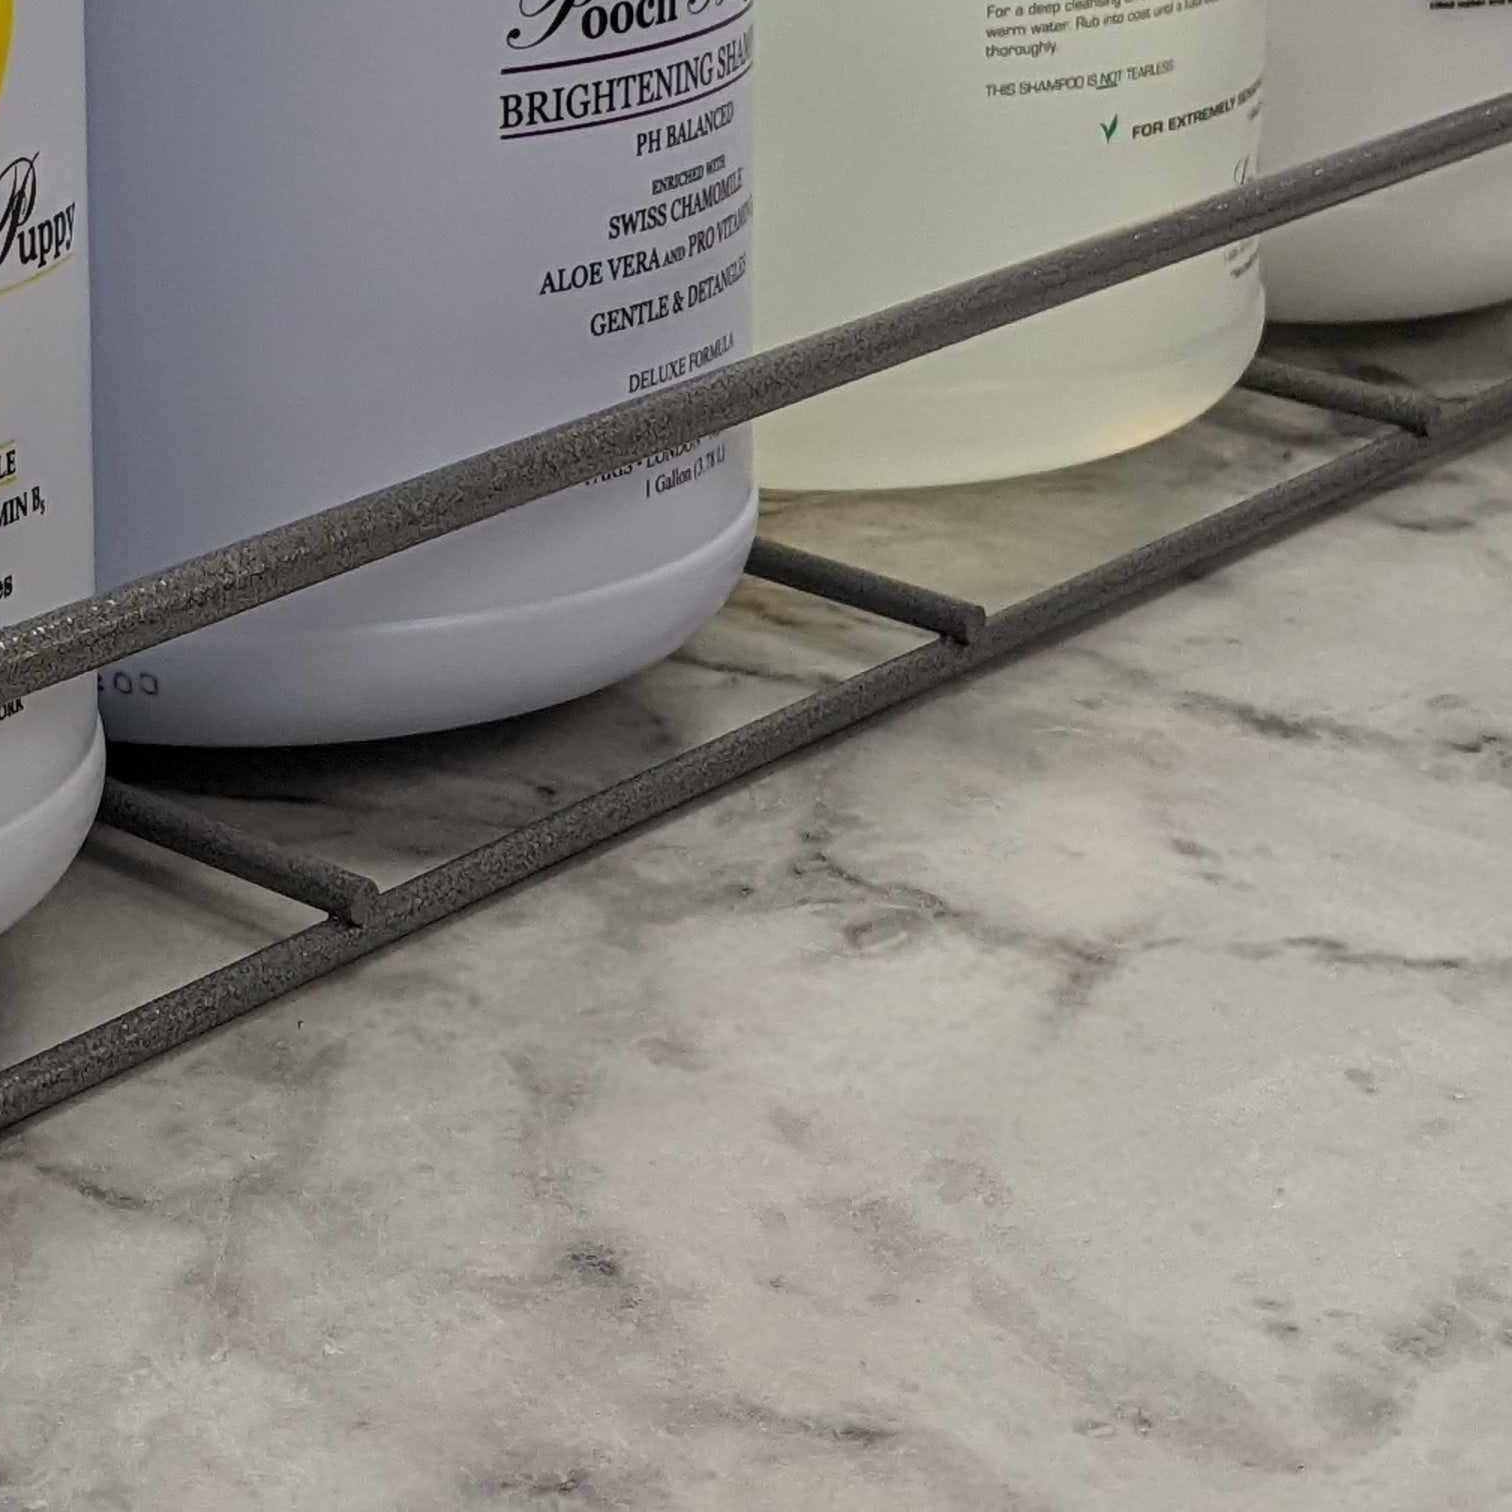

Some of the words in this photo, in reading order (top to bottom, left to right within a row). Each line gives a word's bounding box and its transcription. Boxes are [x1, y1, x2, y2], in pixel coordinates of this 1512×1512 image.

[986, 3, 1012, 20] For
[1015, 5, 1024, 17] a
[986, 24, 1027, 38] warm
[1075, 15, 1101, 31] Rub
[499, 52, 714, 130] BRIGHTENING
[986, 82, 1017, 97] THIS
[1019, 75, 1085, 96] SHAMPOO
[1088, 72, 1098, 87] IS
[1100, 69, 1123, 86] NOT
[636, 128, 662, 157] PH
[666, 101, 735, 149] BALANCED
[1132, 120, 1164, 140] FOR
[1168, 96, 1236, 131] EXTREMELY
[652, 164, 705, 196] ENRICHED
[608, 202, 667, 240] SWISS
[670, 167, 744, 223] CHAMOMILE
[539, 261, 604, 296] ALOE
[607, 247, 661, 281] VERA
[662, 245, 686, 268] AND
[688, 225, 715, 258] PRO
[590, 294, 670, 337] GENTLE
[672, 290, 684, 315] &
[628, 356, 687, 394] DELUXE
[689, 331, 735, 373] FORMULA
[645, 479, 651, 499] 1
[655, 463, 691, 496] Gallon
